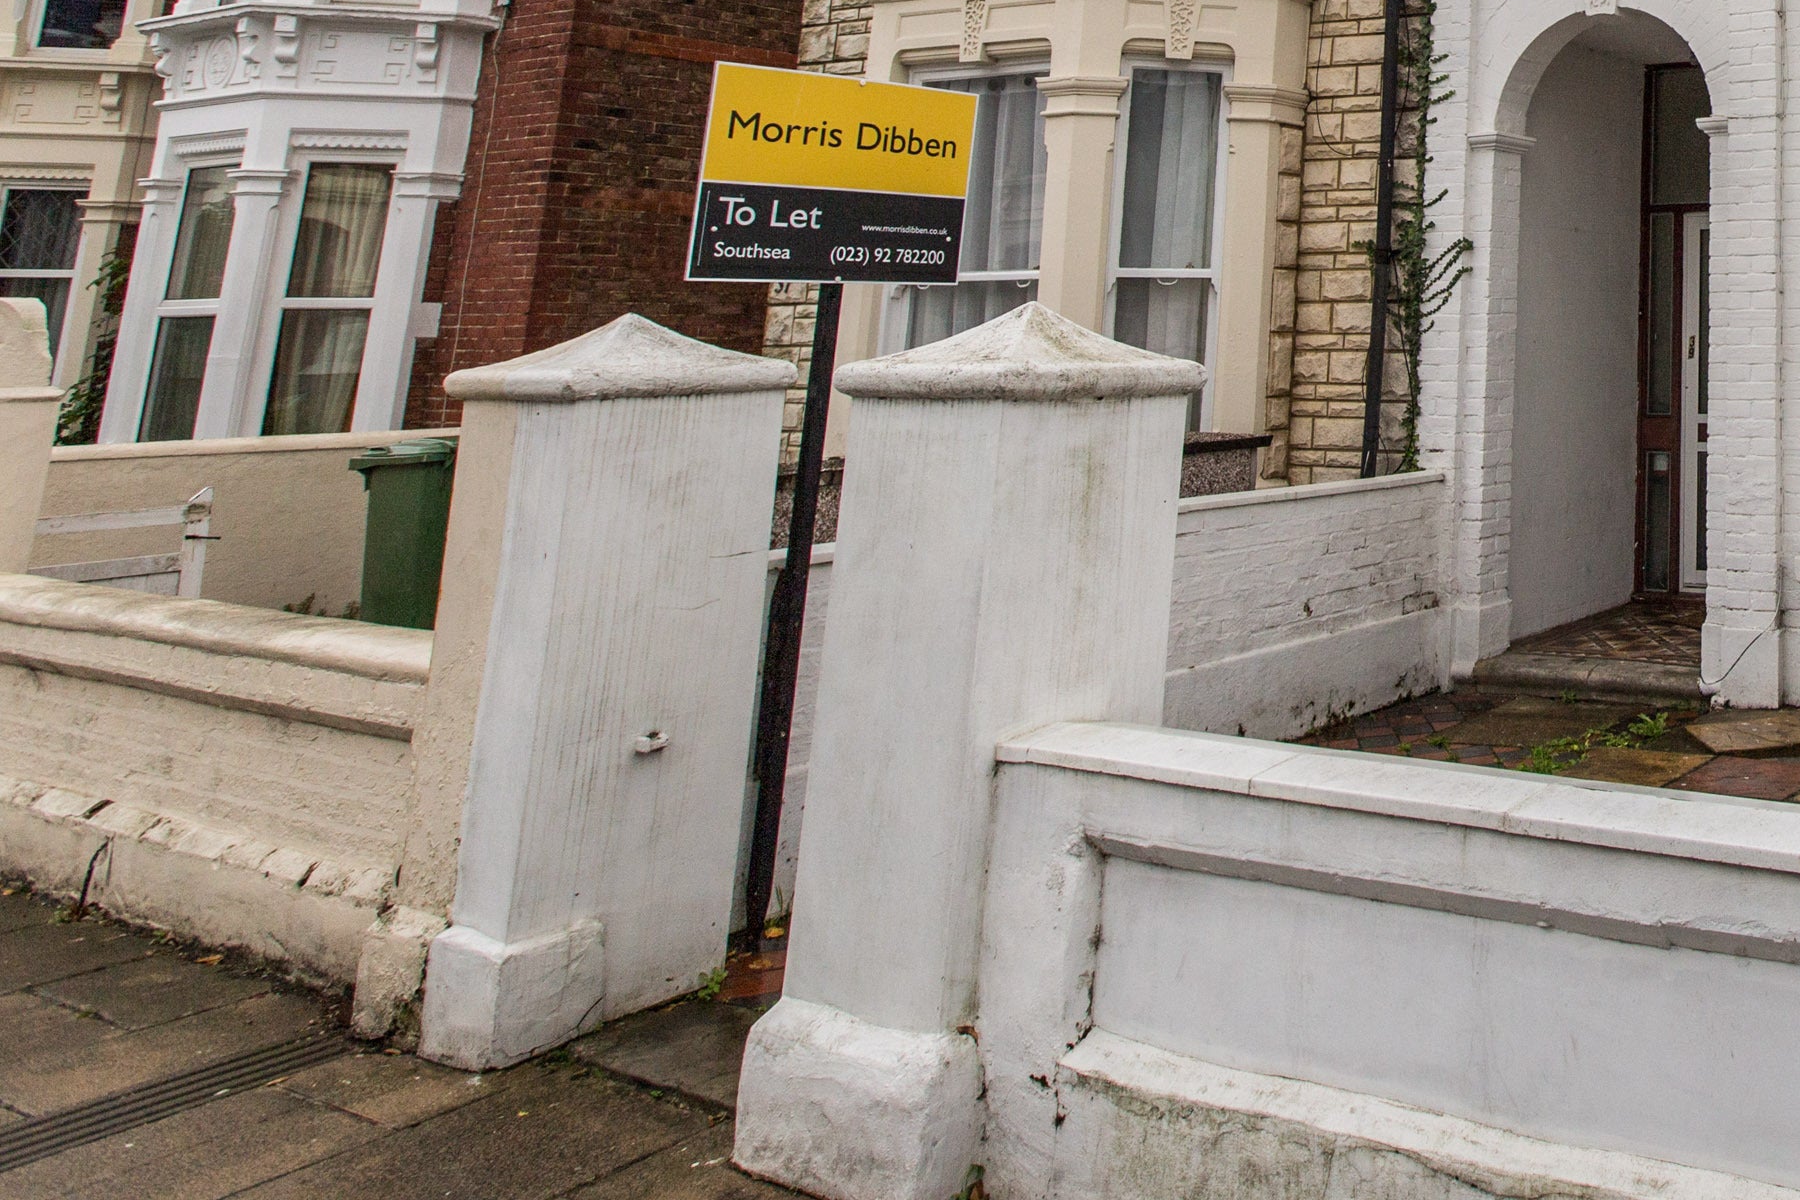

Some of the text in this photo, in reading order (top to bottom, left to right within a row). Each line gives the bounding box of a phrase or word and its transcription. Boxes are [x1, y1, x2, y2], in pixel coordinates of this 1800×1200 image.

[727, 110, 957, 158] Morris Dibben
[719, 196, 823, 229] To Let
[861, 225, 948, 235] www.morrisdibben.co.uk
[713, 241, 791, 260] Southsea
[830, 246, 945, 266] (023) 92 782200
